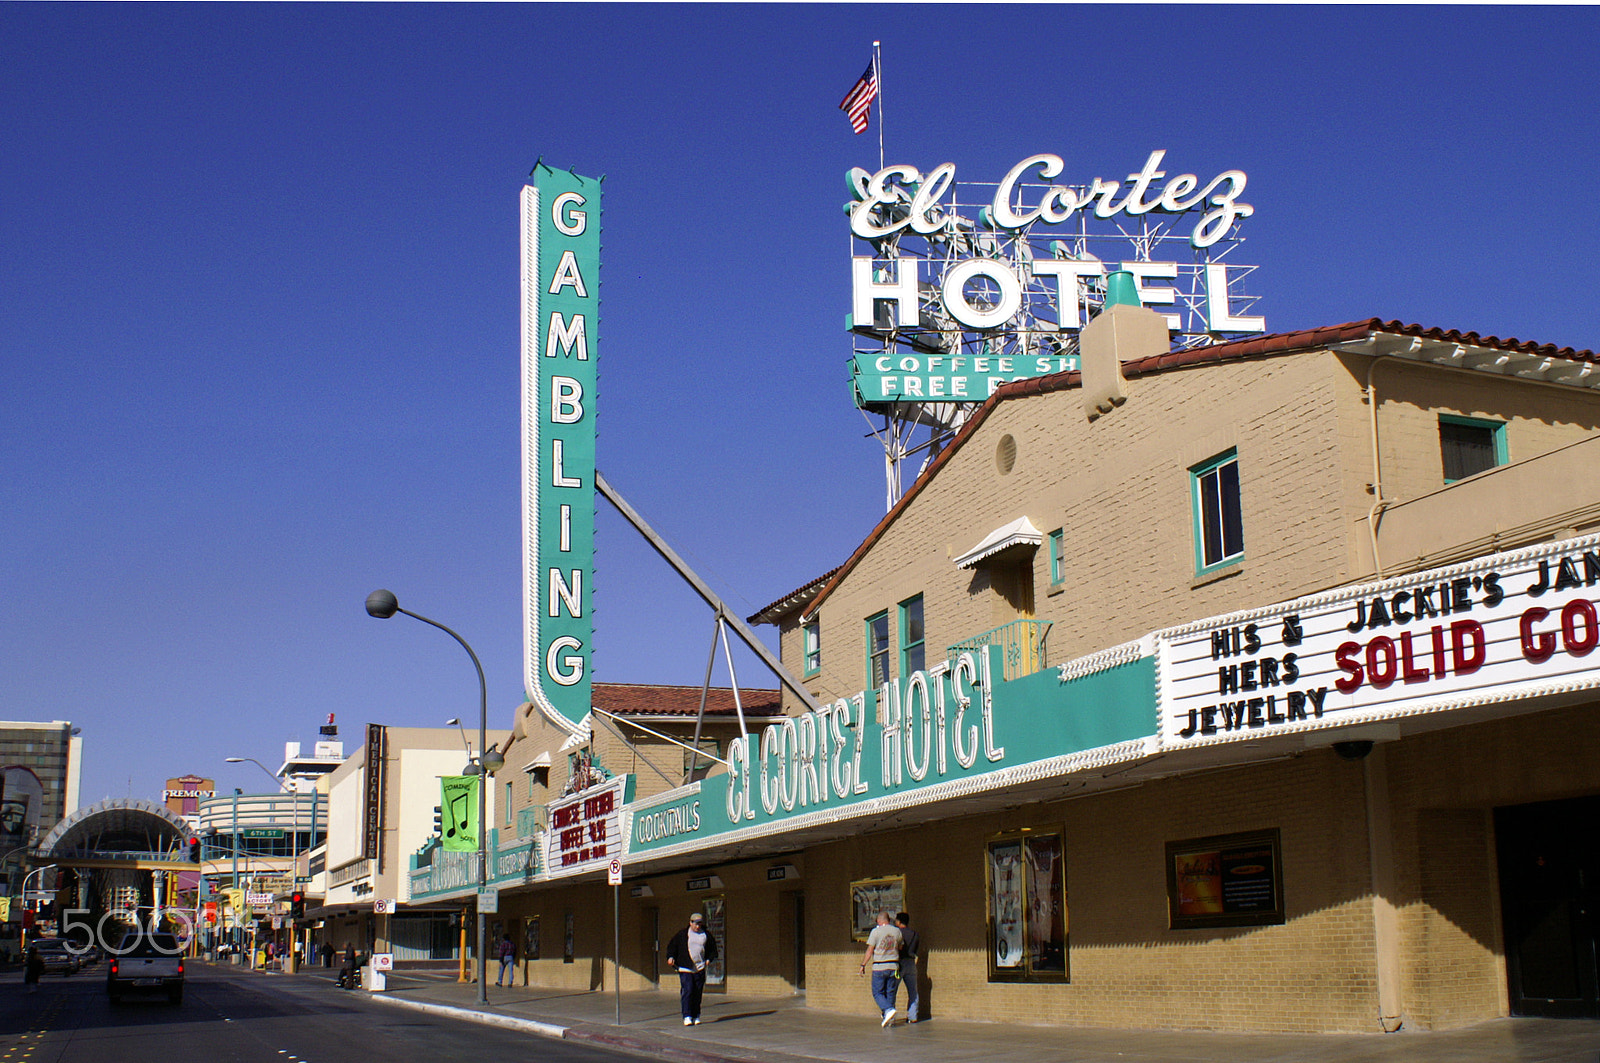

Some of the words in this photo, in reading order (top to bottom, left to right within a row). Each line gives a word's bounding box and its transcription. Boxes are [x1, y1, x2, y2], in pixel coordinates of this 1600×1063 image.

[851, 162, 956, 240] El
[992, 149, 1255, 249] Cortez
[852, 255, 1266, 333] HOTEL
[875, 356, 1014, 373] COFFEE
[881, 376, 968, 397] FREE
[545, 191, 589, 687] GAMBLING
[1347, 572, 1504, 634] JACKIE'S
[1210, 624, 1261, 661] HIS
[1282, 615, 1304, 647] &
[1335, 619, 1486, 695] SOLID
[1519, 598, 1600, 665] GO
[1218, 652, 1300, 696] HERS
[759, 691, 869, 816] CORTEZ
[881, 644, 1006, 788] HOTEL
[1179, 687, 1328, 739] JEWELRY
[161, 789, 219, 802] FREMONT
[369, 743, 380, 802] MEDICAL
[443, 783, 471, 793] COMING
[367, 806, 377, 858] CENTER
[636, 801, 701, 845] COCKTAILS
